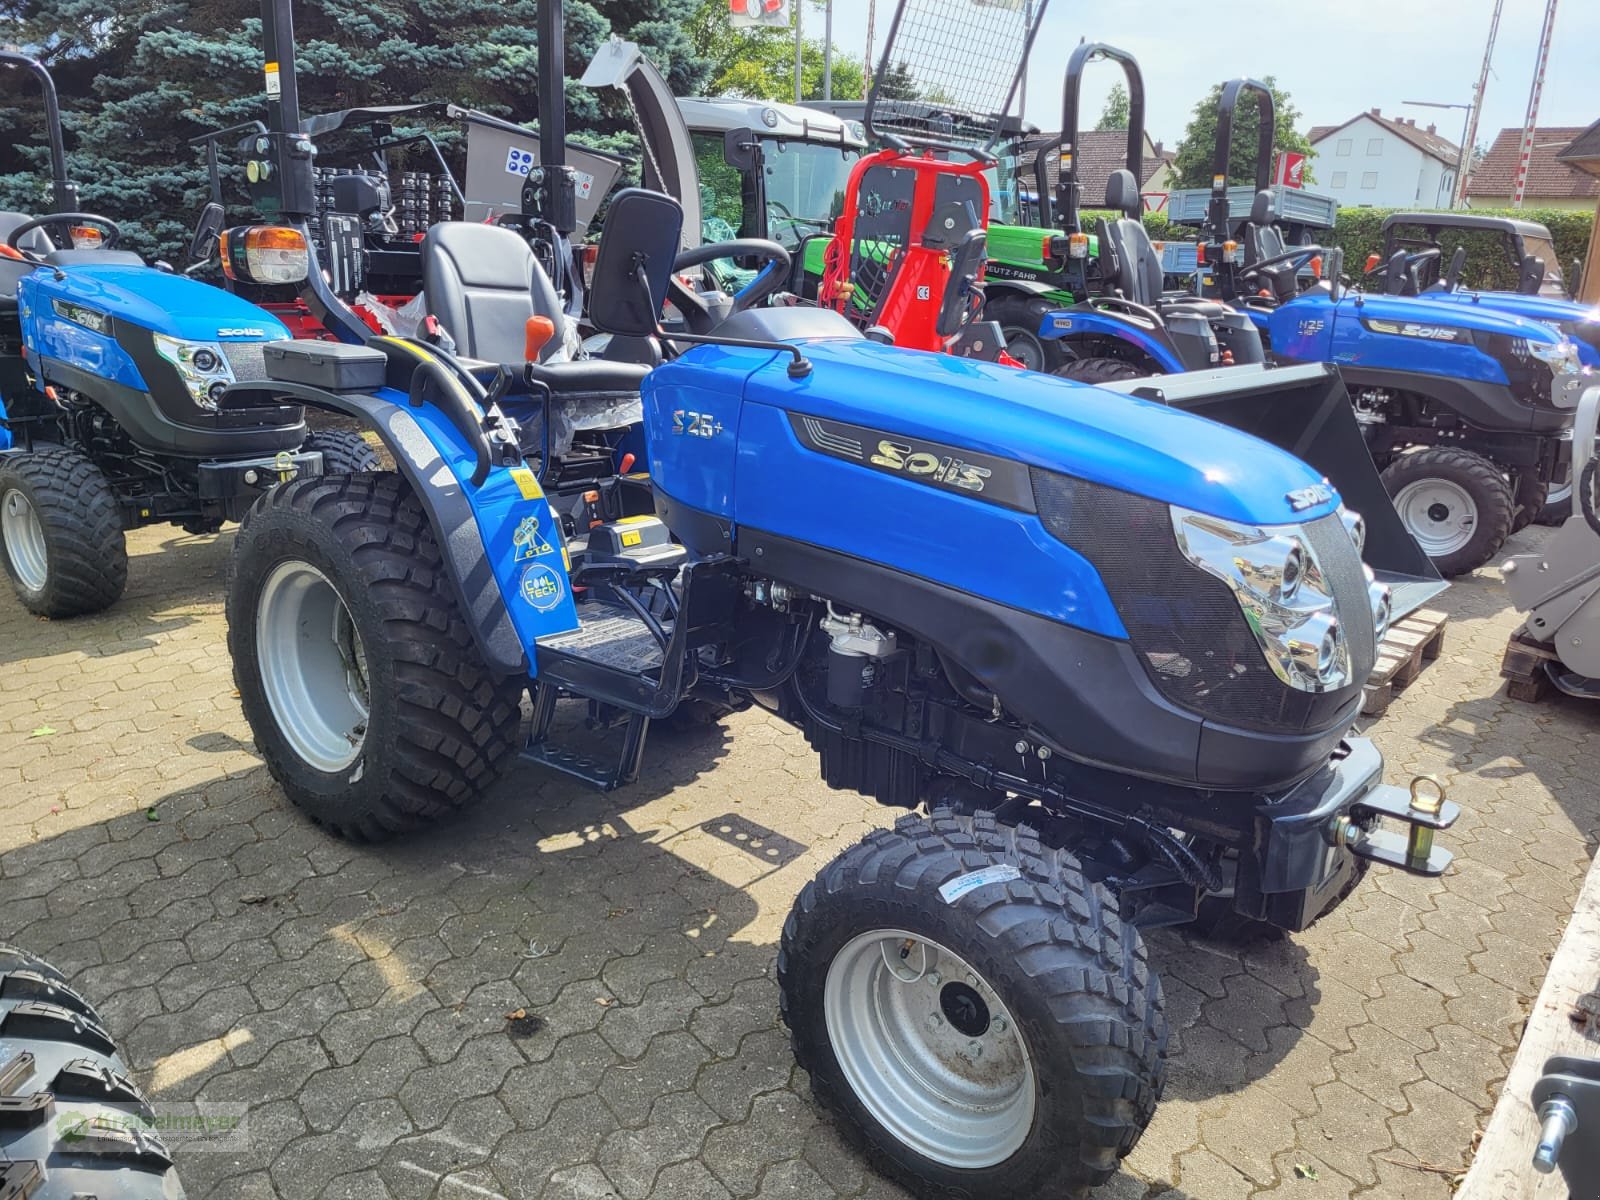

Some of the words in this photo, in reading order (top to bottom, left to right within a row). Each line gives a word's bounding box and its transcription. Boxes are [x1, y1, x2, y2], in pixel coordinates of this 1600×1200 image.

[984, 264, 1037, 281] DEUTZ-FAHR
[525, 543, 551, 559] PTO
[527, 584, 557, 600] TECH
